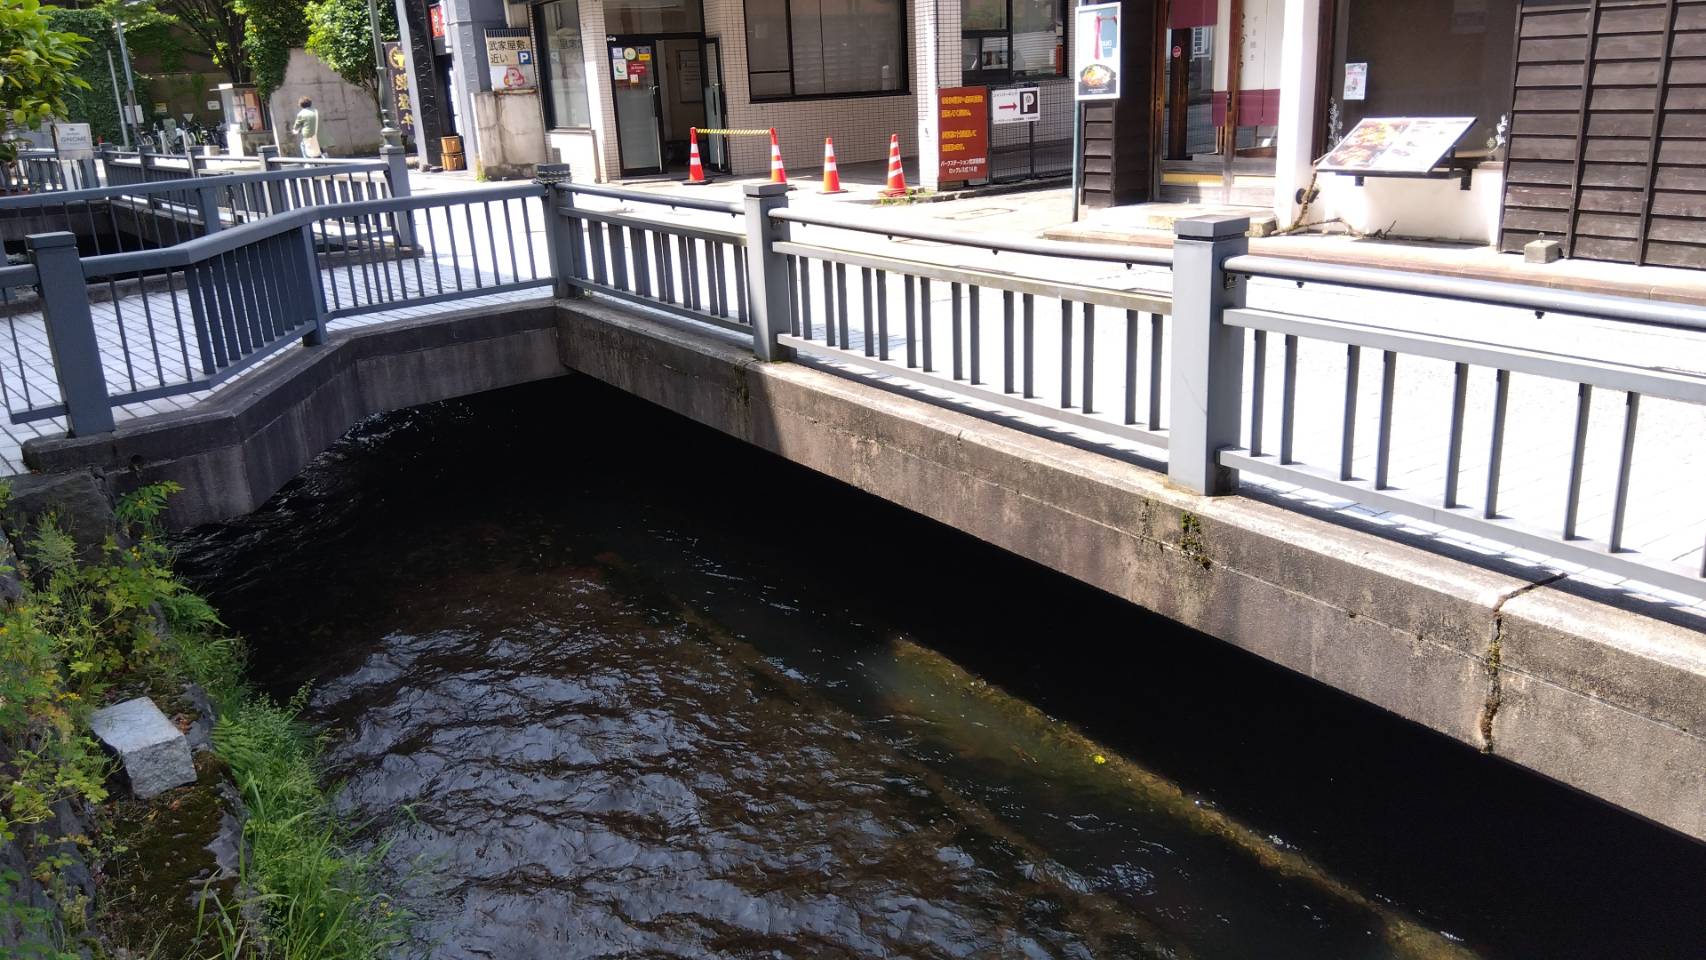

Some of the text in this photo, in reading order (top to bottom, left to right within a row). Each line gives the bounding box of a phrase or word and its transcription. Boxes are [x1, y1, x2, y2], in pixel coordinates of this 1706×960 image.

[490, 53, 509, 63] 近い
[519, 52, 529, 63] P
[1023, 92, 1035, 113] P
